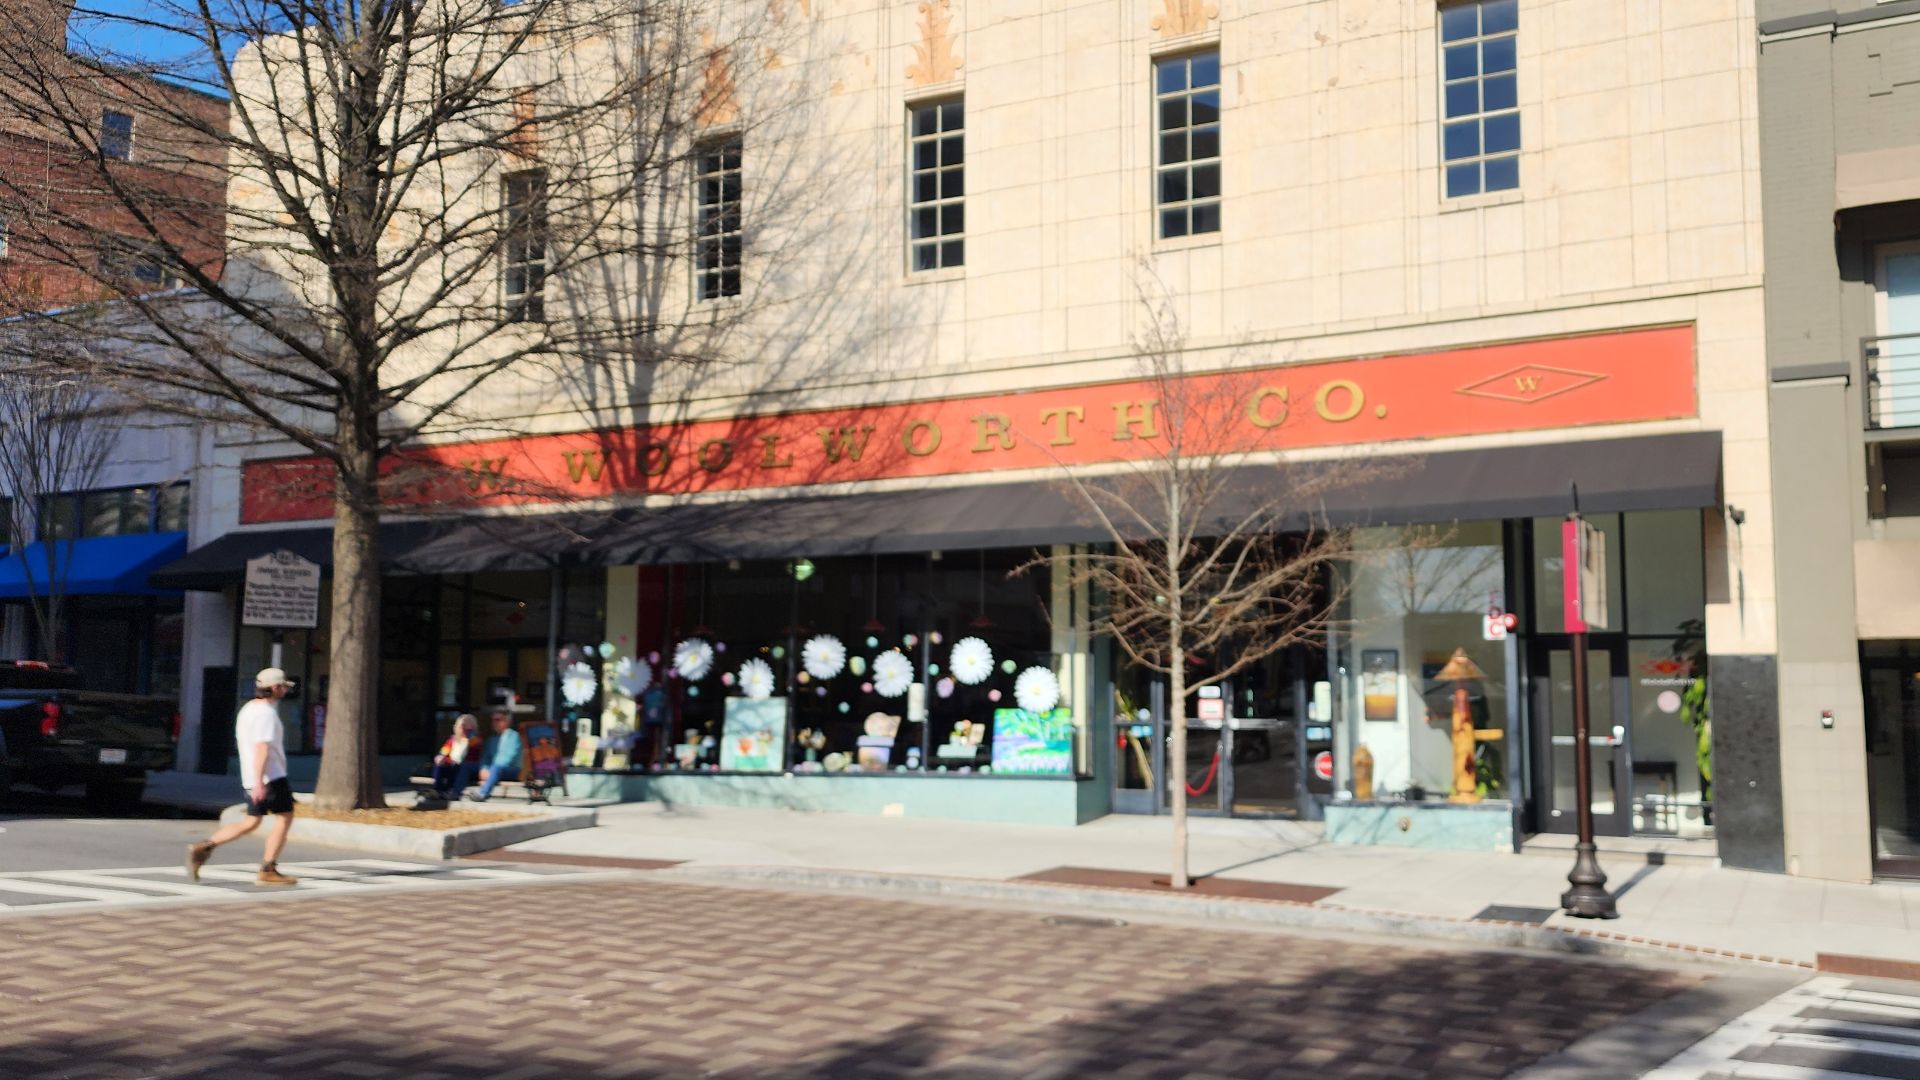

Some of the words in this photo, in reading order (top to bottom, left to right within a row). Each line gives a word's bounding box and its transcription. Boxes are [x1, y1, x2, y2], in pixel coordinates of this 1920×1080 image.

[1513, 375, 1541, 392] W
[561, 400, 1160, 482] WOOLWORTH
[1247, 380, 1387, 429] CO.
